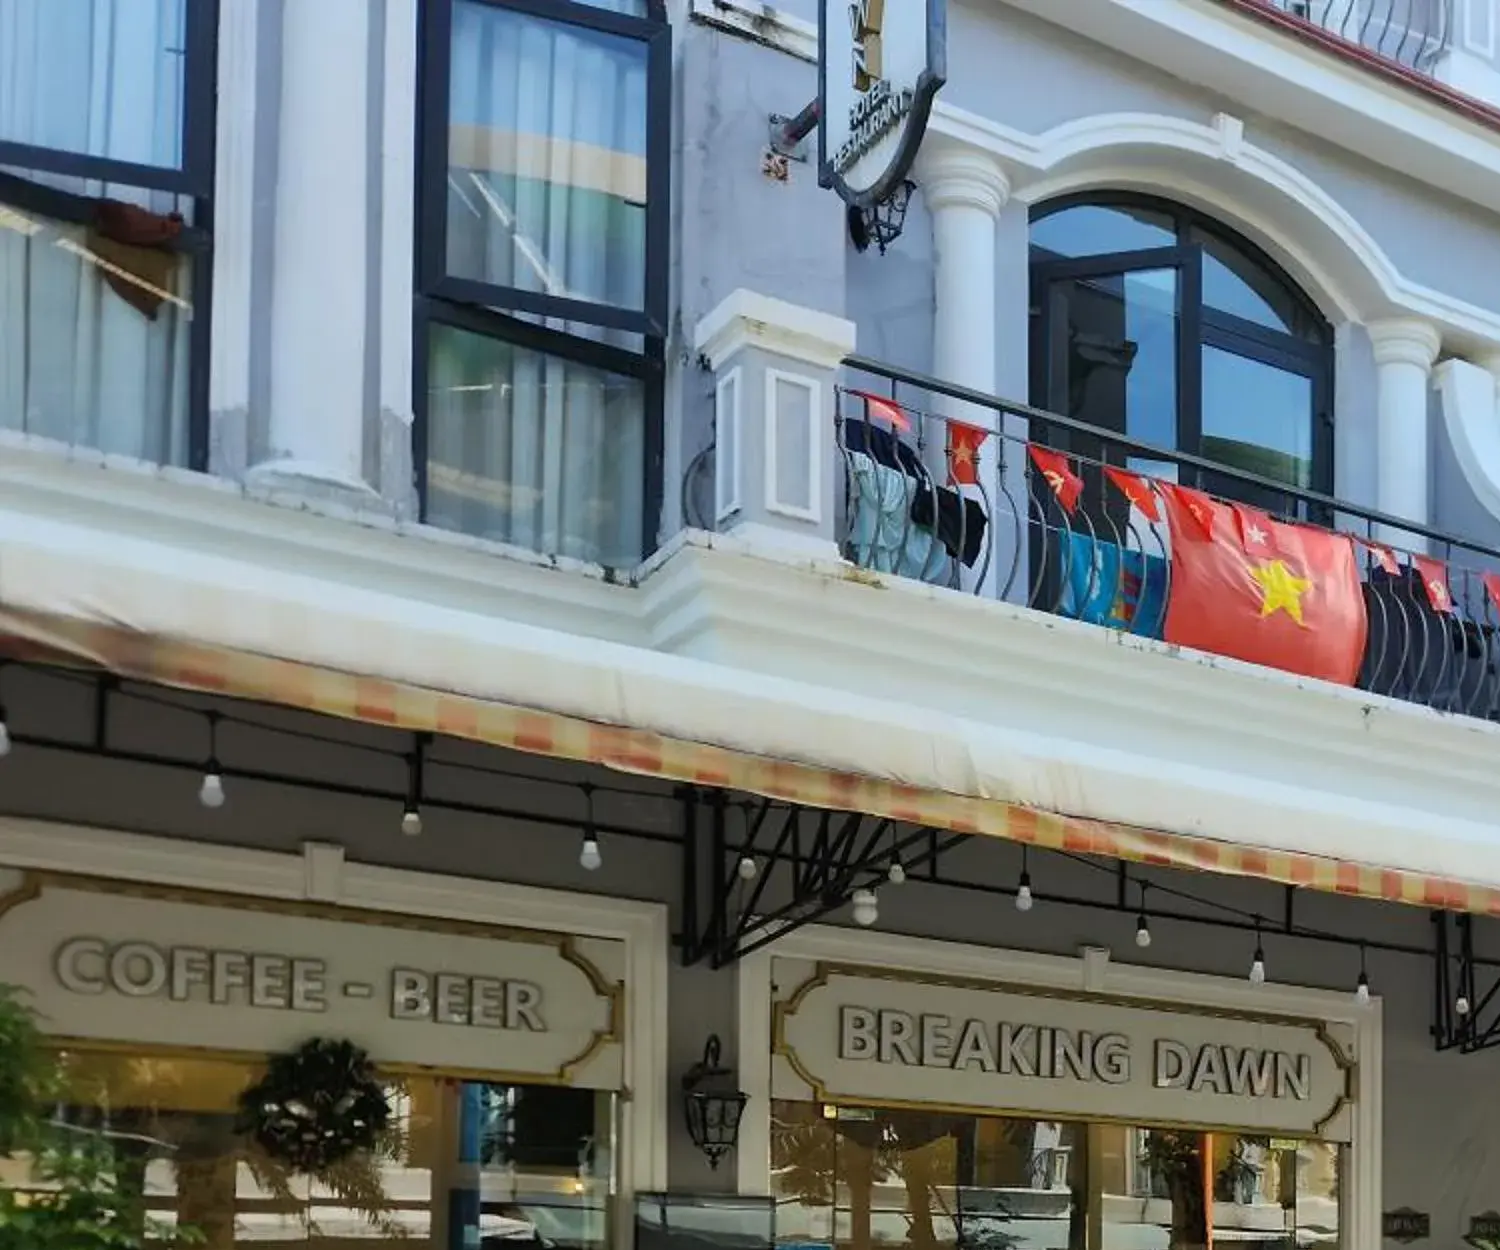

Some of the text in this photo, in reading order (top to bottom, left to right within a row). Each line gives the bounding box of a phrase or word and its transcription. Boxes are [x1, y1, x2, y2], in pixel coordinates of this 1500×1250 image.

[54, 934, 328, 1014] COFFEE
[391, 966, 547, 1033] BEER
[839, 1005, 1312, 1101] BREAKING DAWN
